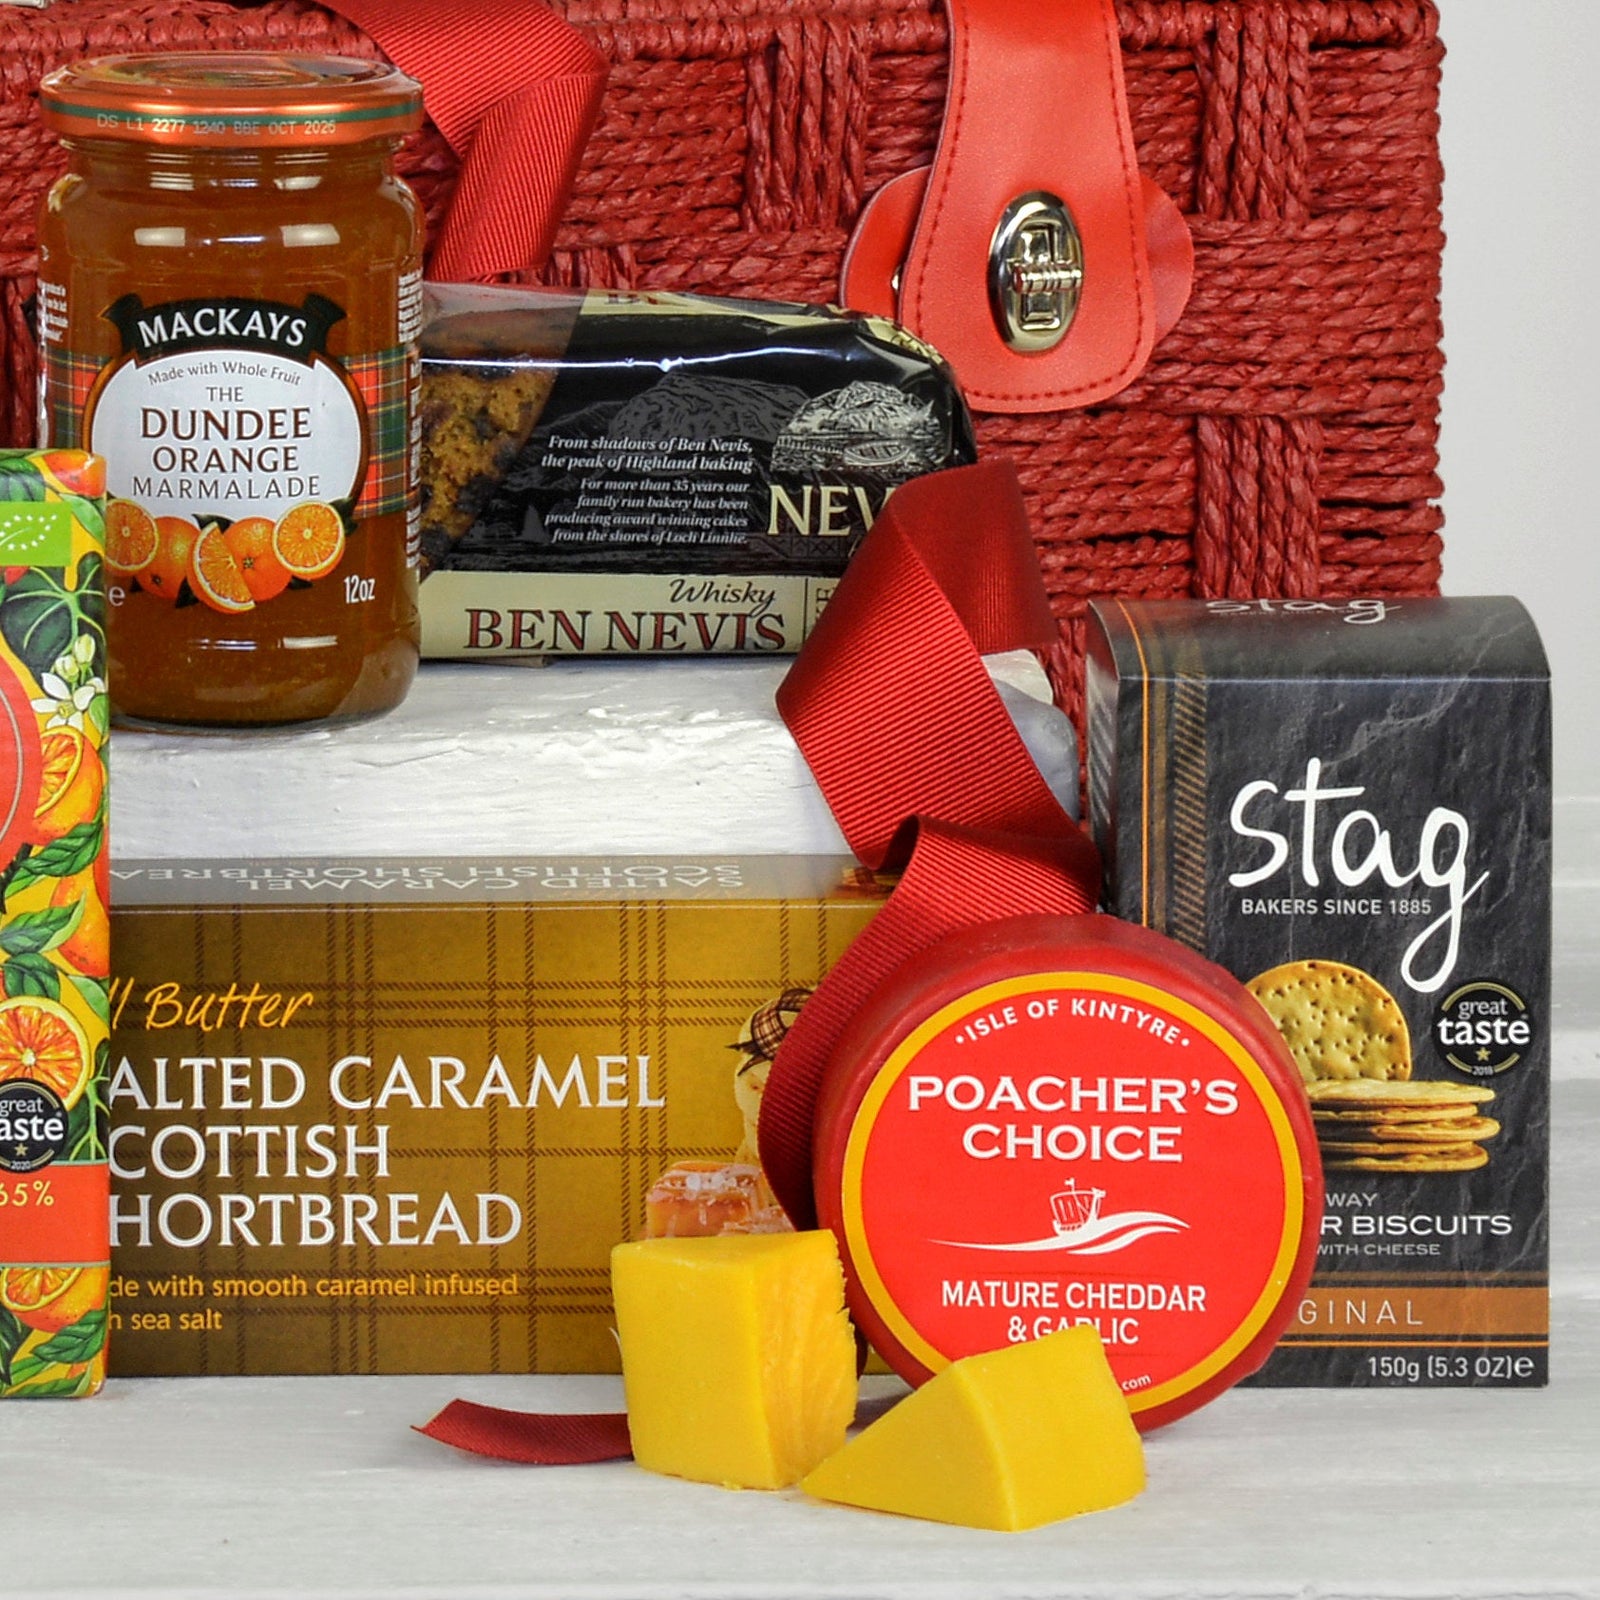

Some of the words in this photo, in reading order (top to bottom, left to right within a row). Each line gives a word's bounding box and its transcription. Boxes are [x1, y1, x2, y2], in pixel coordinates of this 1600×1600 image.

[97, 113, 119, 129] DS
[126, 117, 144, 131] L1
[151, 118, 186, 133] 2277
[193, 121, 226, 134] 1240
[234, 121, 260, 135] BBE
[269, 121, 296, 135] OCT
[137, 308, 307, 347] MACKAYS
[148, 367, 184, 386] Made
[188, 361, 218, 375] with
[222, 361, 267, 377] Whole
[271, 367, 301, 386] Fruit
[206, 387, 244, 402] THE
[141, 407, 312, 441] DUNDEE
[548, 436, 588, 449] From
[591, 436, 656, 450] shadows
[659, 437, 678, 454] of
[677, 438, 705, 451] Ben
[152, 446, 299, 474] ORANGE
[541, 454, 566, 467] the
[567, 455, 604, 471] peak
[607, 455, 626, 471] of
[626, 455, 697, 471] Highland
[700, 457, 753, 474] baking
[132, 476, 320, 500] MARMALADE
[580, 478, 603, 490] For
[604, 481, 638, 491] more
[640, 479, 671, 491] than
[672, 480, 689, 492] 35
[689, 481, 724, 495] years
[726, 483, 750, 493] our
[575, 495, 620, 510] family
[621, 498, 645, 508] run
[647, 496, 690, 511] bakery
[693, 497, 717, 509] has
[718, 498, 749, 510] been
[767, 484, 897, 536] NEV
[544, 512, 611, 527] producing
[612, 513, 656, 526] award
[657, 515, 711, 529] winning
[713, 515, 748, 527] cakes
[551, 530, 585, 544] from
[586, 530, 608, 542] the
[609, 531, 650, 543] shores
[651, 532, 670, 546] of
[666, 532, 697, 544] Loch
[344, 575, 376, 604] 12oz
[669, 578, 776, 619] Whisky
[463, 608, 591, 651] BEN
[604, 611, 786, 652] NEVIS
[237, 877, 518, 891] CARAMEL
[468, 865, 741, 878] SCOTTISH
[541, 876, 743, 889] SALTED
[1241, 899, 1318, 915] BAKERS
[1323, 899, 1381, 915] SINCE
[1388, 899, 1431, 915] 1885
[145, 982, 314, 1032] Butter
[1458, 998, 1509, 1020] great
[964, 1005, 1018, 1041] ISLE
[1026, 999, 1060, 1020] OF
[1071, 998, 1182, 1044] KINTYRE
[1437, 1017, 1530, 1045] taste
[109, 1054, 306, 1110] ALTED
[329, 1054, 666, 1109] CARAMEL
[908, 1075, 1239, 1115] POACHER'S
[0, 1115, 64, 1141] aste
[108, 1123, 390, 1179] COTTISH
[962, 1123, 1183, 1163] CHOICE
[1325, 1192, 1378, 1207] WAY
[109, 1192, 522, 1248] HORTBREAD
[1352, 1215, 1513, 1235] BISCUITS
[1363, 1243, 1441, 1256] CHEESE
[147, 1274, 204, 1297] with
[213, 1275, 308, 1298] smooth
[316, 1275, 416, 1297] caramel
[425, 1274, 519, 1297] infused
[942, 1280, 1059, 1309] MATURE
[1065, 1282, 1206, 1312] CHEDDAR
[131, 1313, 171, 1330] sea
[179, 1308, 223, 1330] salt
[1297, 1300, 1423, 1325] GINAL
[1008, 1315, 1027, 1343] &
[1033, 1315, 1139, 1344] GLIC
[1368, 1356, 1420, 1382] 150g
[1427, 1355, 1468, 1379] (5.3
